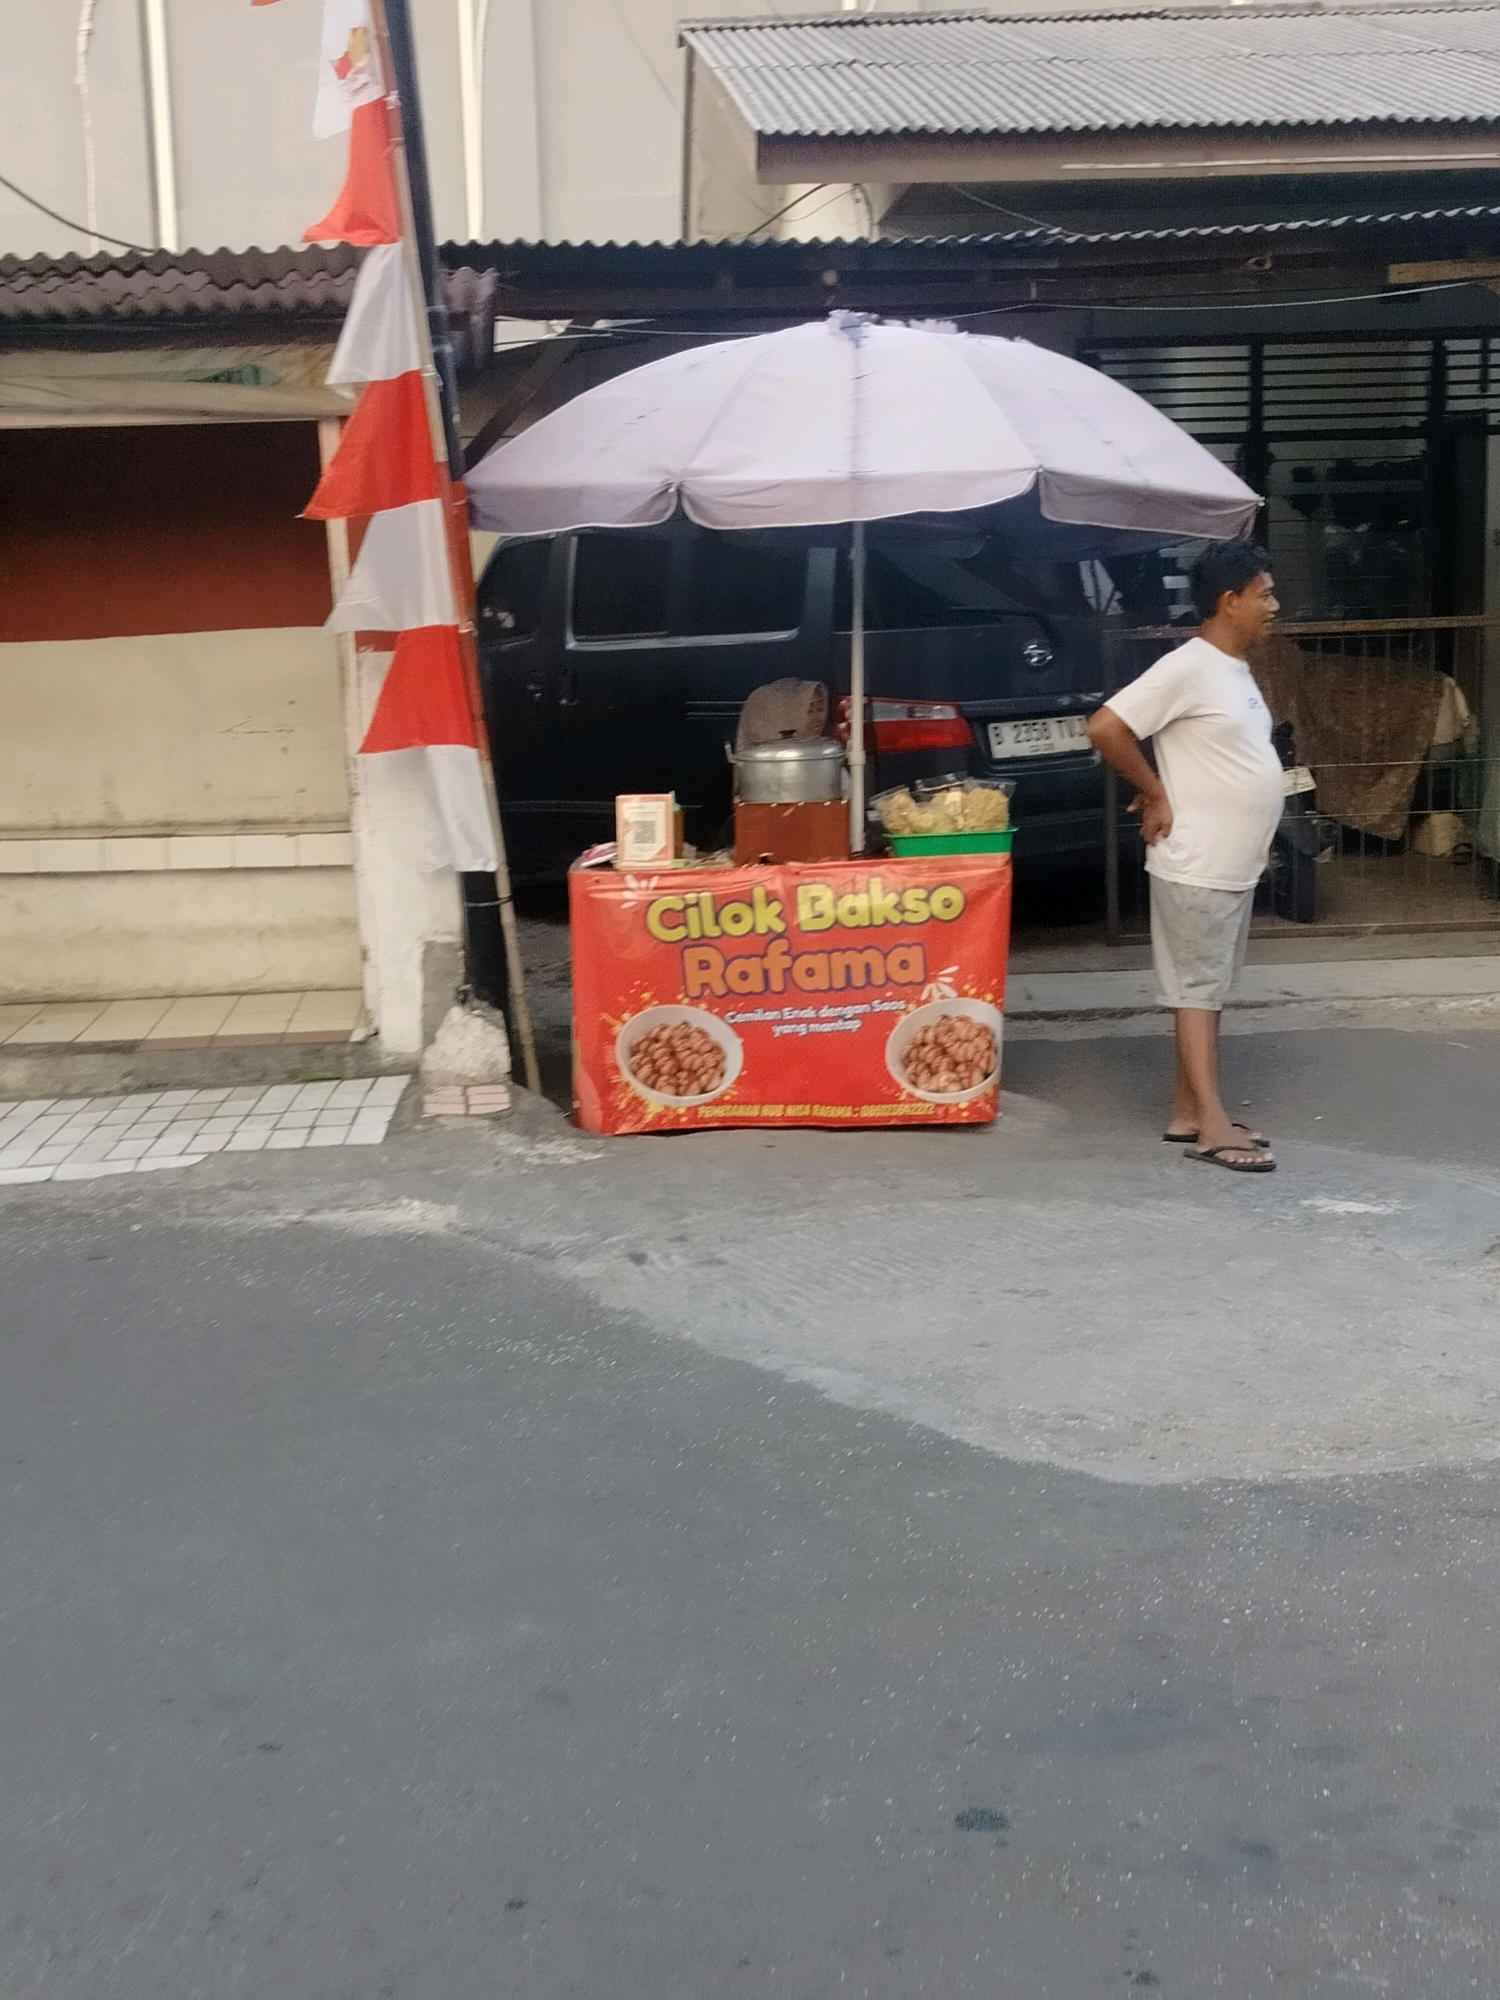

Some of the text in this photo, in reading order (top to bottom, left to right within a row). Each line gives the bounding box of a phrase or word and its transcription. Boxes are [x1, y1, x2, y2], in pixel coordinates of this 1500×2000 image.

[993, 725, 1004, 745] B
[645, 877, 966, 943] Cilok Bakso
[682, 938, 927, 998] Rafama
[782, 1006, 817, 1020] Enak
[818, 1003, 871, 1019] dengan
[872, 1000, 907, 1012] Saos
[771, 1019, 862, 1037] yang mantap
